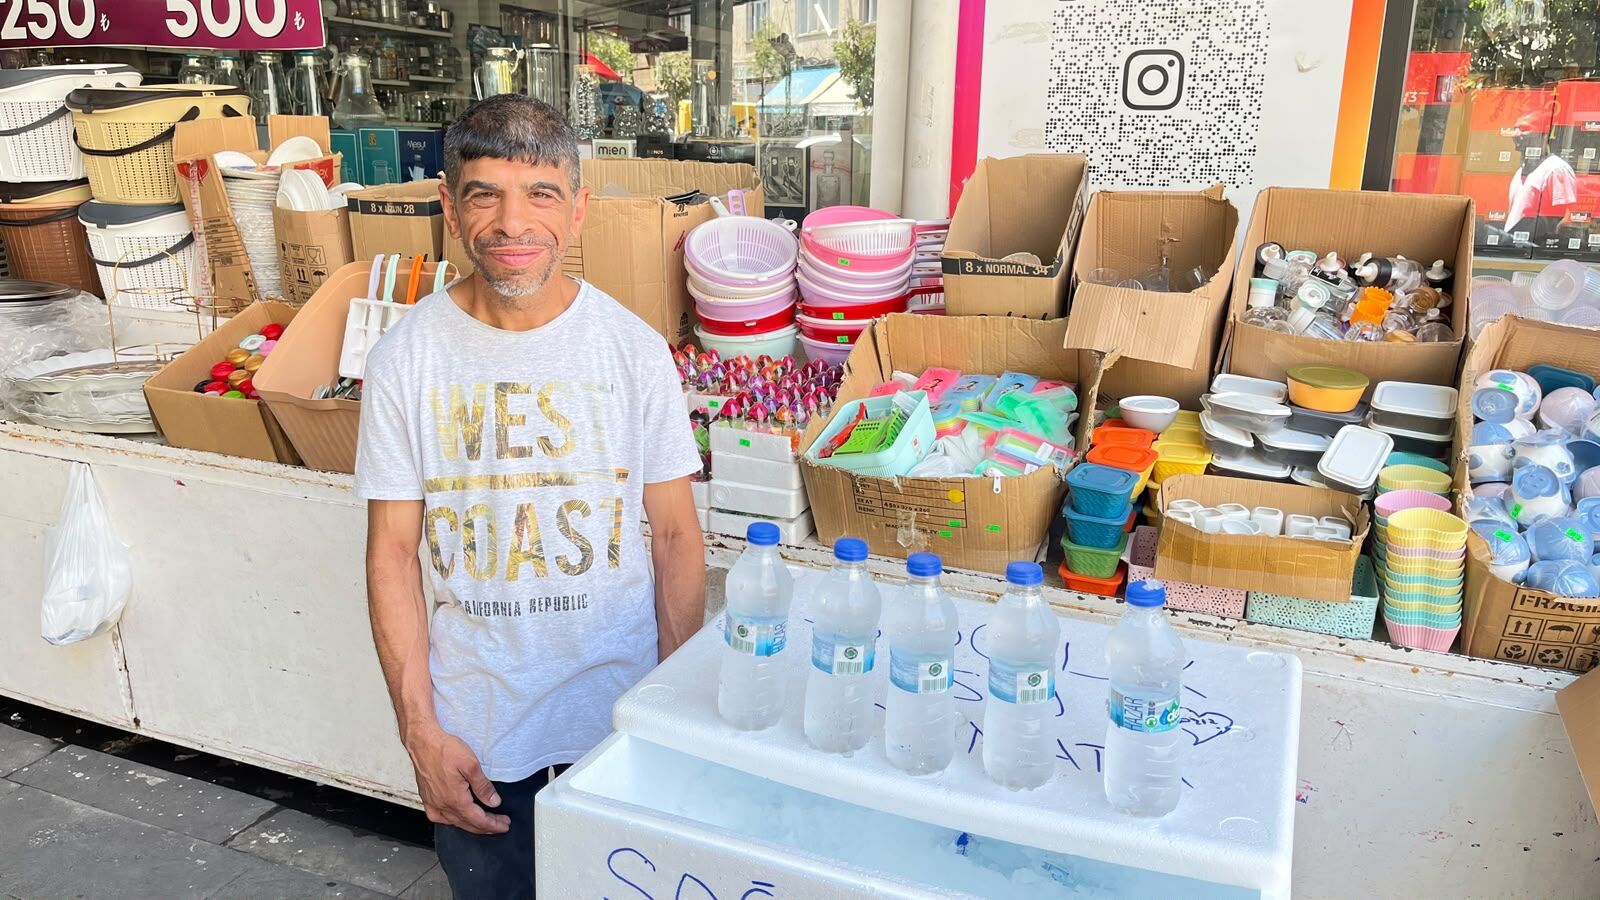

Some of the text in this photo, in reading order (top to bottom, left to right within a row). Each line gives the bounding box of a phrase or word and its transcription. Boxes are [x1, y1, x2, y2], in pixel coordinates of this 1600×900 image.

[0, 0, 96, 40] 250
[165, 0, 288, 39] 500
[598, 145, 627, 156] mien
[370, 203, 377, 213] 8
[403, 204, 415, 214] 28
[965, 261, 1048, 276] 8 x NORMAL 34
[429, 381, 614, 461] WEST
[426, 496, 625, 582] COAST
[529, 593, 588, 614] REPUBLIC
[1124, 696, 1144, 732] HAZAR
